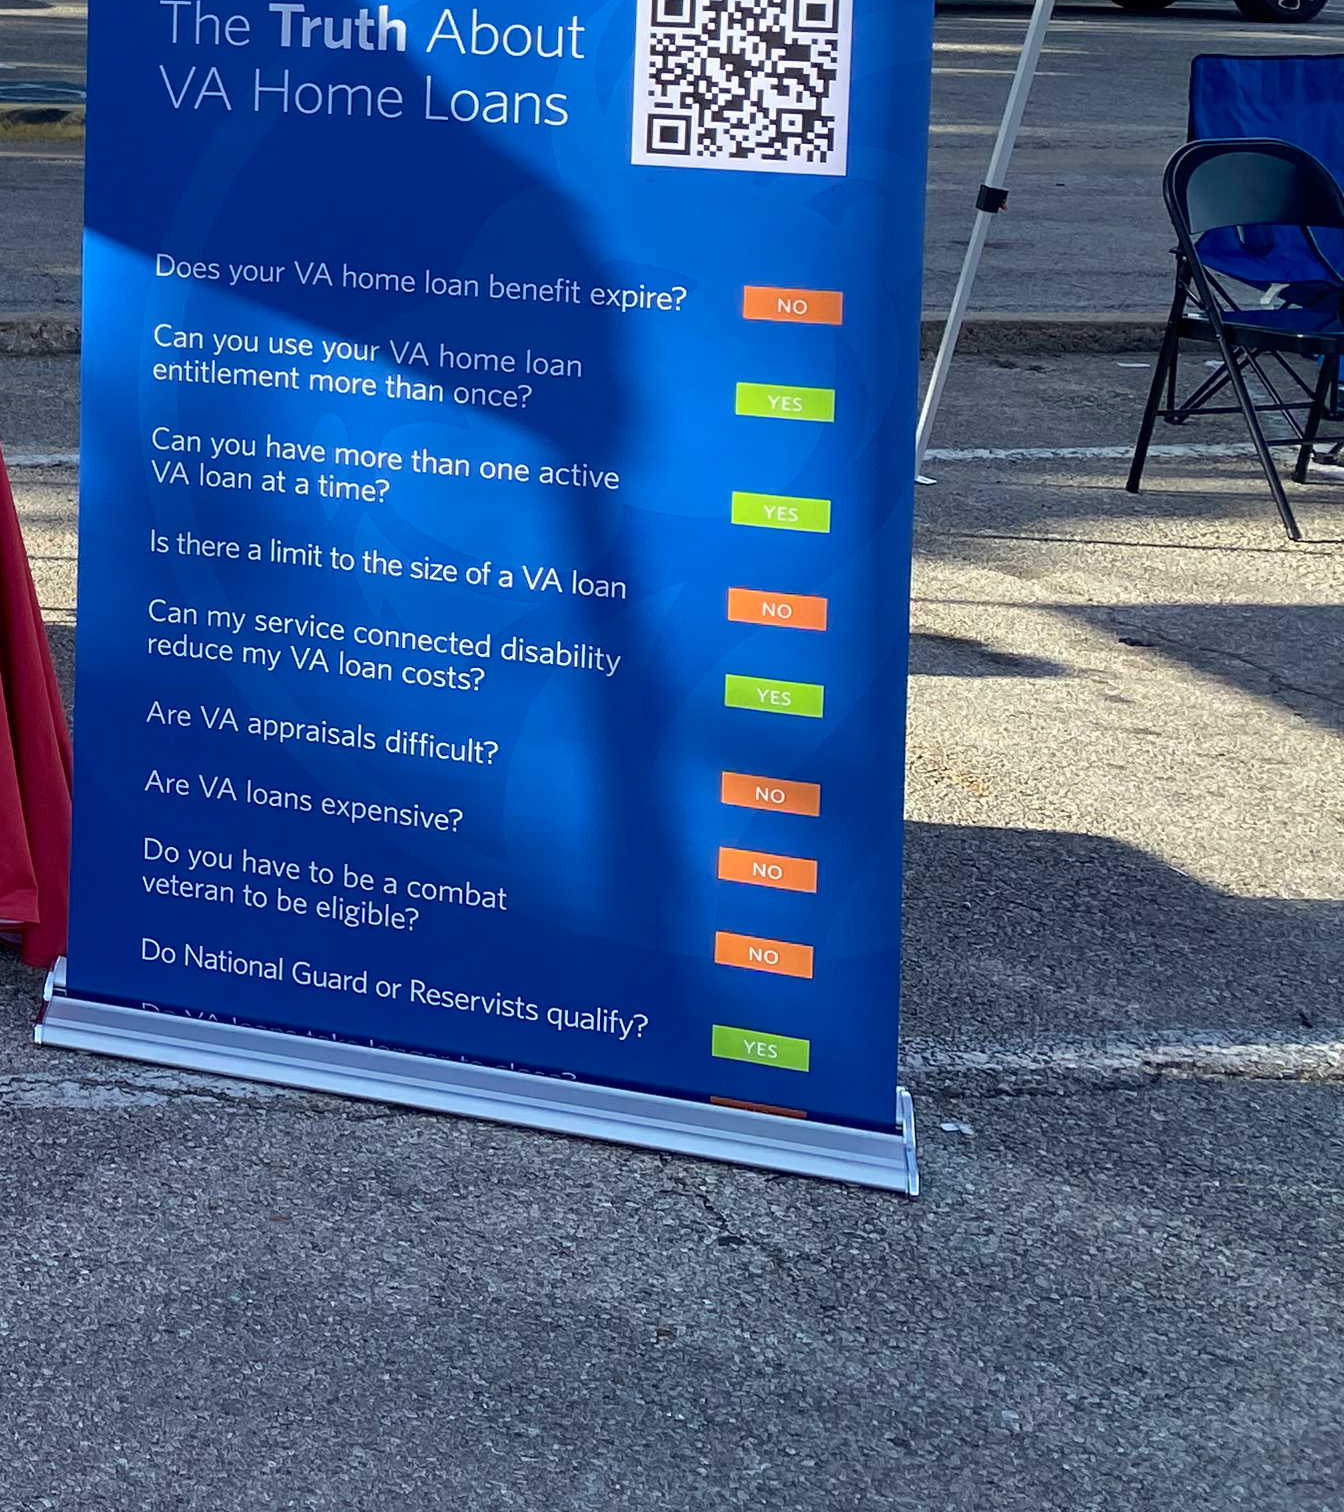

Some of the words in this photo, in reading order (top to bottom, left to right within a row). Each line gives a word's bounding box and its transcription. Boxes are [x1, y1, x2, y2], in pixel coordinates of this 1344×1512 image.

[160, 0, 250, 46] The
[269, 3, 407, 51] Truth
[426, 8, 585, 59] About
[159, 65, 231, 110] VA
[255, 69, 402, 118] Home
[426, 75, 568, 126] Loans
[156, 254, 220, 279] Does
[229, 264, 285, 286] your
[294, 261, 333, 286] VA
[343, 263, 415, 292] home
[426, 270, 478, 297] loan
[490, 274, 580, 303] benefit
[590, 284, 687, 312] expire?
[778, 298, 807, 314] NO
[154, 324, 203, 349] Can
[213, 334, 258, 355] you
[269, 337, 313, 356] use
[322, 341, 380, 363] your
[390, 340, 429, 366] VA
[440, 343, 515, 372] home
[527, 349, 581, 377] loan
[153, 360, 300, 389] entitlement
[310, 374, 376, 396] more
[385, 374, 443, 402] than
[454, 385, 532, 408] once?
[768, 395, 802, 412] YES
[764, 505, 798, 522] YES
[763, 602, 792, 618] NO
[757, 688, 791, 706] YES
[146, 701, 191, 726] Are
[201, 706, 238, 731] VA
[248, 718, 376, 749] appraisals
[386, 729, 498, 764] difficult?
[145, 770, 189, 795] Are
[199, 775, 237, 801] VA
[247, 780, 312, 811] loans
[322, 798, 463, 832] expensive?
[756, 787, 785, 803] NO
[753, 862, 782, 879] NO
[749, 947, 778, 964] NO
[142, 938, 176, 963] Do
[185, 944, 283, 980] National
[292, 961, 367, 994] Guard
[376, 981, 402, 999] or
[411, 979, 538, 1020] Reservists
[547, 1007, 648, 1040] qualify?
[744, 1040, 777, 1058] YES
